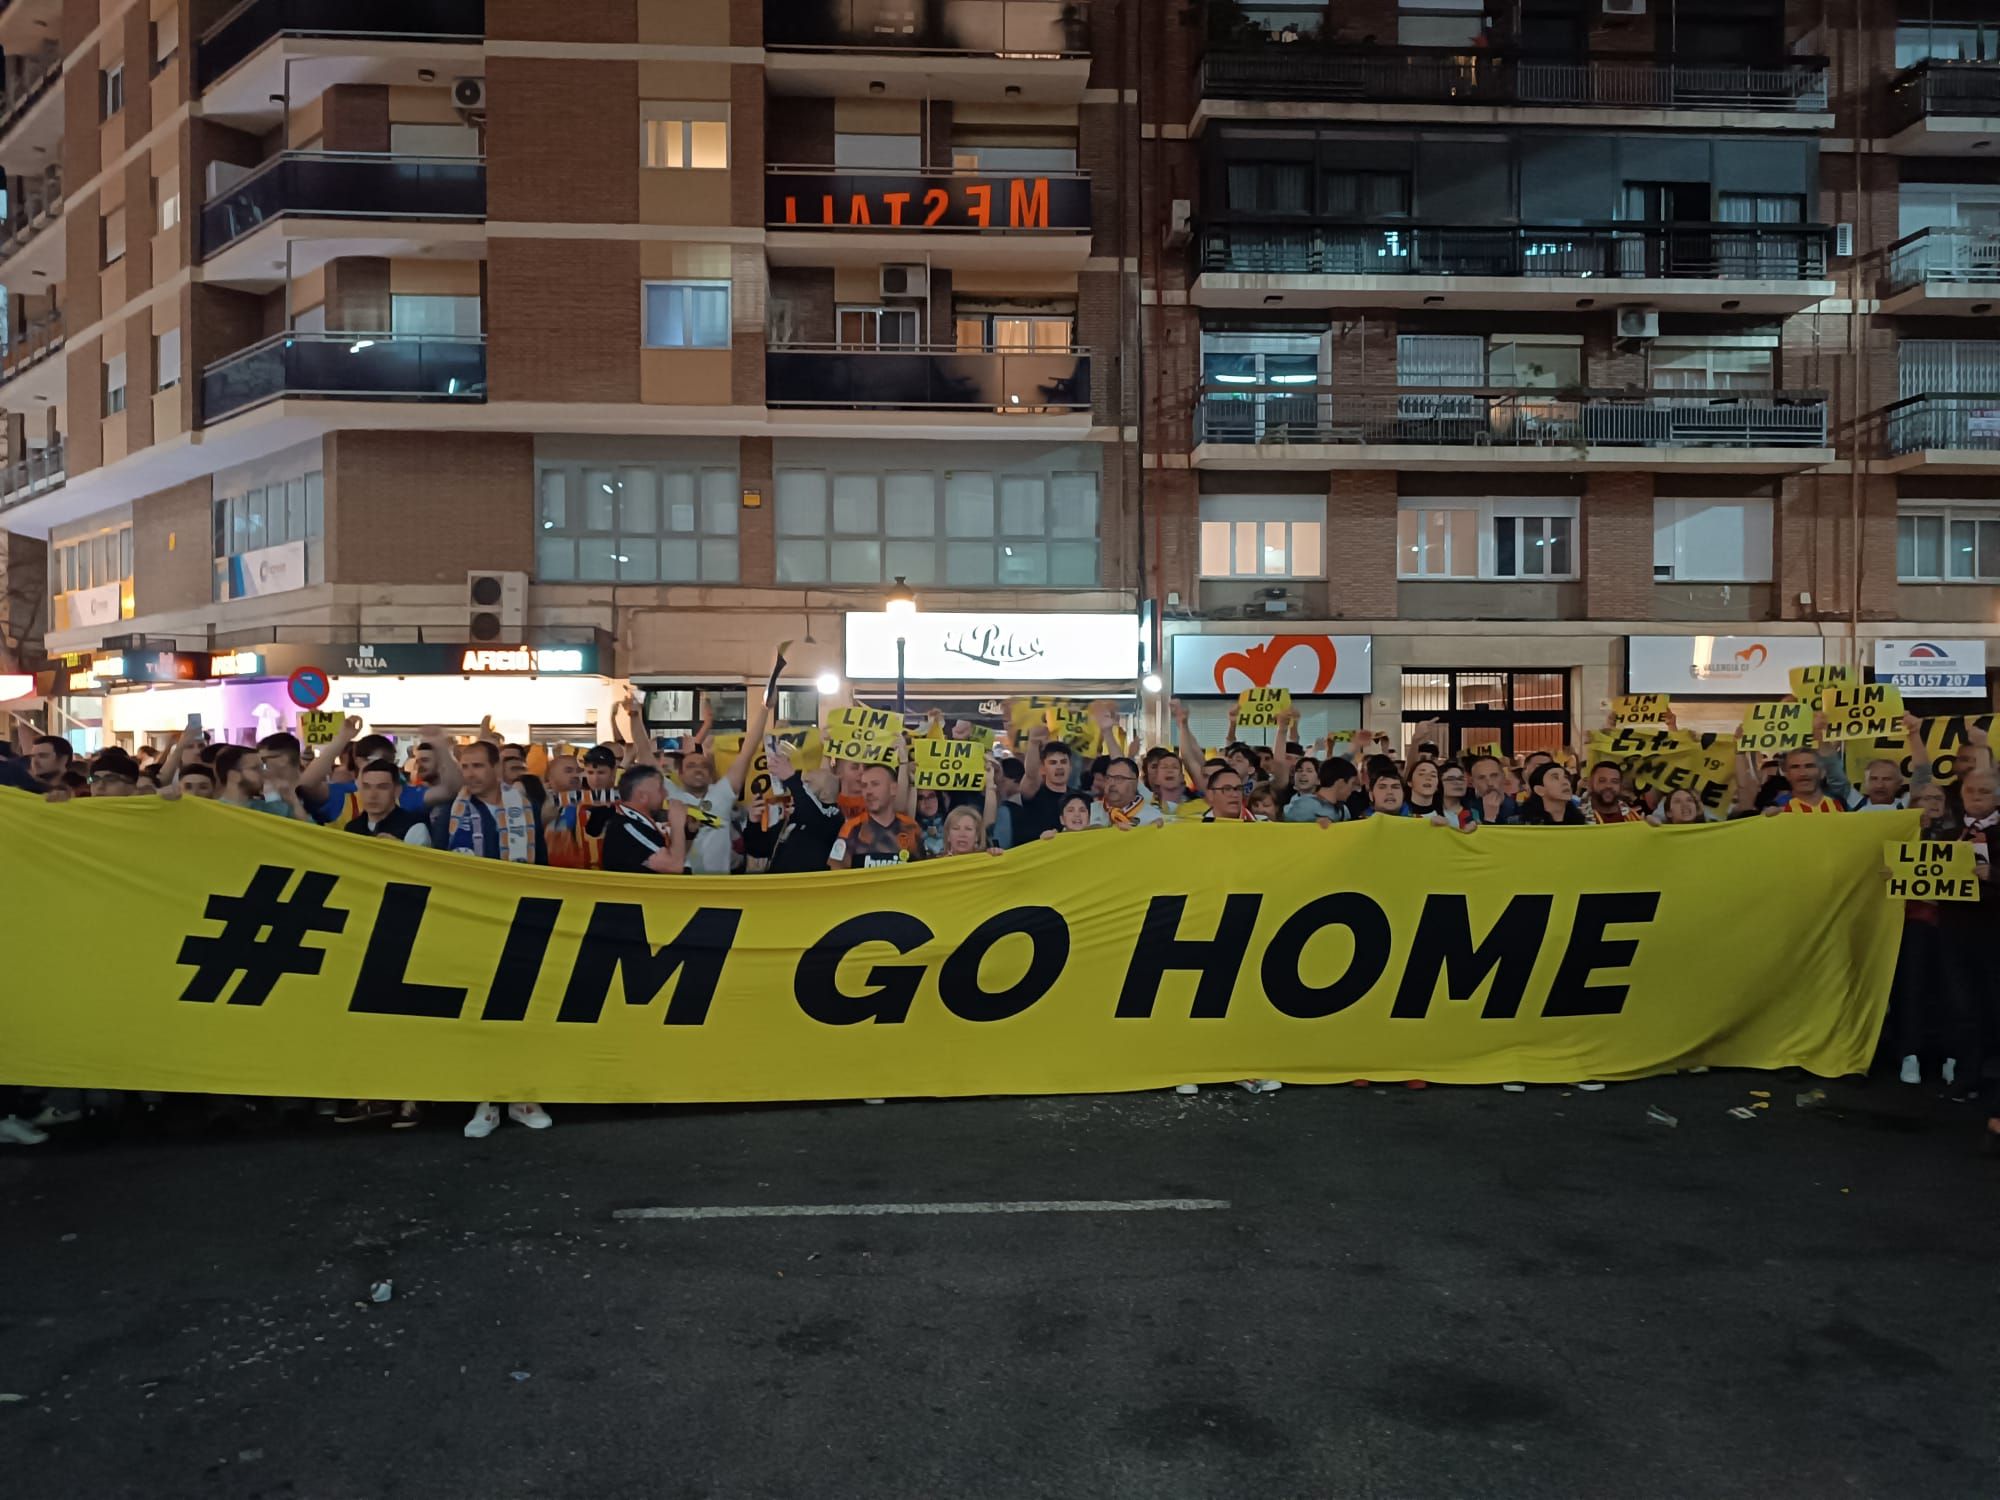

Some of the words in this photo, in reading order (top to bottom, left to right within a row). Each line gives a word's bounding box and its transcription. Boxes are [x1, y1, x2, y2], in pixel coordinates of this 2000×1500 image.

[346, 657, 388, 669] TURIA
[1802, 667, 1846, 684] LIM
[1891, 674, 1915, 686] 658
[1918, 674, 1942, 686] 057
[1946, 674, 1970, 686] 207
[1248, 688, 1282, 702] LIM
[1623, 695, 1658, 707] LIM
[1835, 685, 1885, 707] LIM
[1255, 703, 1274, 712] GO
[1630, 705, 1649, 713] GO
[1753, 704, 1801, 720] LIM
[1849, 705, 1876, 719] GO
[843, 708, 889, 730] LIM
[1238, 713, 1278, 726] HOM
[1615, 712, 1666, 723] HOME
[1764, 720, 1790, 732] GO
[1826, 715, 1905, 738] HOME
[852, 728, 876, 742] GO
[1741, 733, 1815, 748] HOME
[827, 739, 896, 763] HOME
[930, 741, 972, 758] LIM
[940, 759, 963, 770] GO
[919, 771, 985, 788] HOME
[1900, 843, 1953, 862] LIM
[1914, 864, 1944, 877] GO
[1891, 879, 1975, 897] HOME
[177, 864, 743, 1026] #LIM
[793, 905, 1071, 1026] GO
[1114, 891, 1662, 1020] HOME
